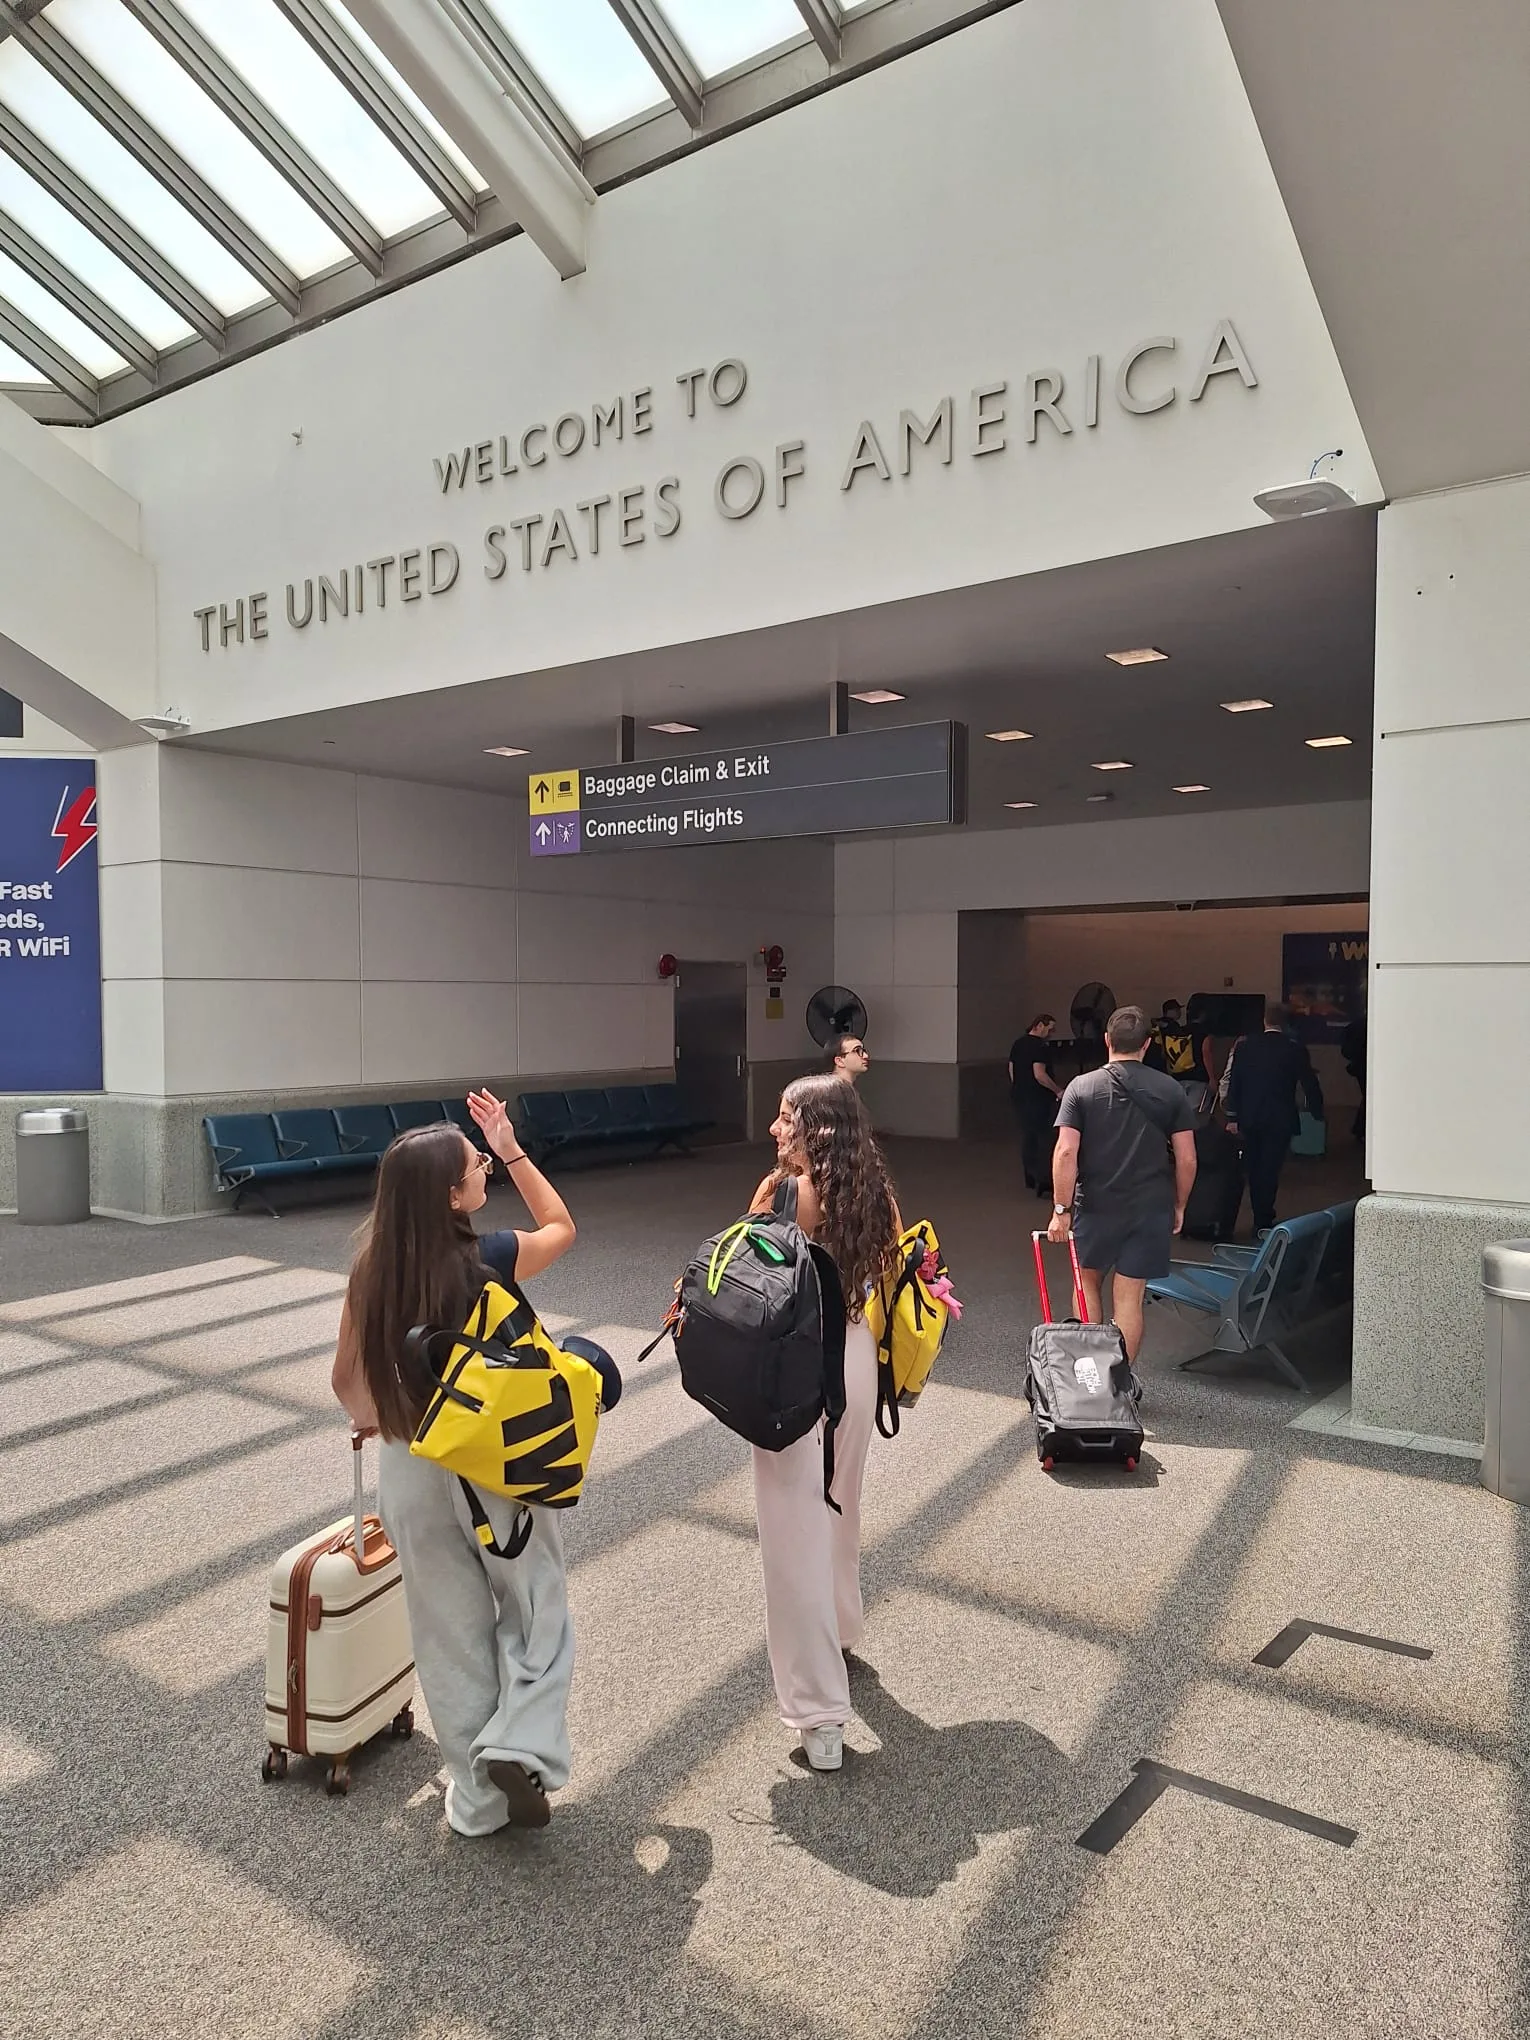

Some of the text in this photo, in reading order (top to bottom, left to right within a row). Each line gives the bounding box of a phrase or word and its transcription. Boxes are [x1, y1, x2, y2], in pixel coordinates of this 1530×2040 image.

[432, 358, 750, 494] WELCOME TO
[194, 319, 1260, 652] THE UNITED STATES OF AMERICA
[584, 755, 770, 797] Baggage Claim & Exit
[585, 807, 744, 839] Connecting Flights
[0, 881, 53, 900] Fast
[16, 935, 70, 957] WiFi
